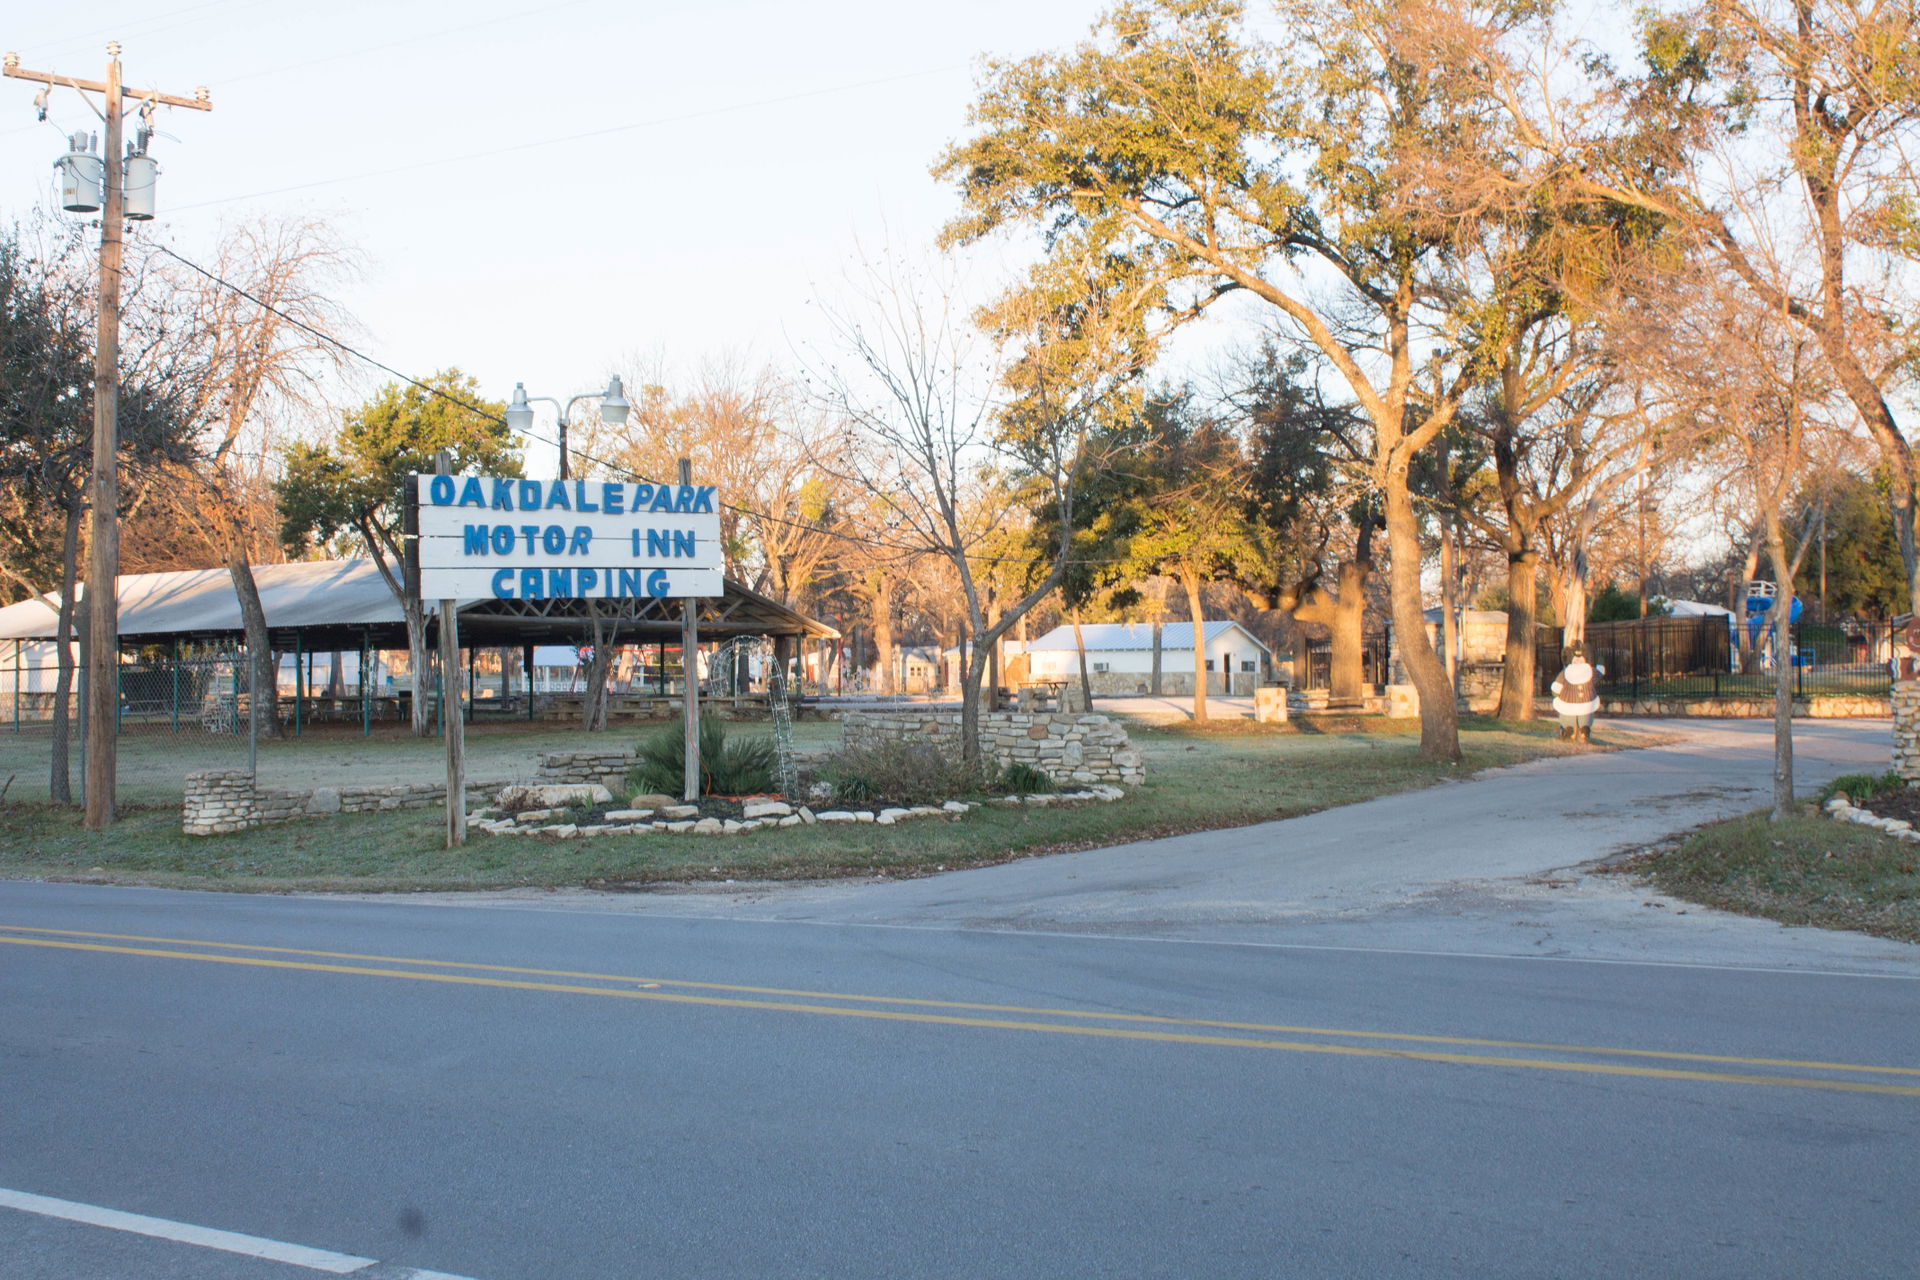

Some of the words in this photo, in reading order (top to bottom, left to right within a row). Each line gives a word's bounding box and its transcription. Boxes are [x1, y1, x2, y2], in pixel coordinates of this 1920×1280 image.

[429, 474, 625, 515] OAKDALE
[630, 483, 718, 514] PARK
[463, 523, 593, 556] MOTOR
[631, 527, 696, 558] INN
[490, 567, 671, 600] CAMPING
